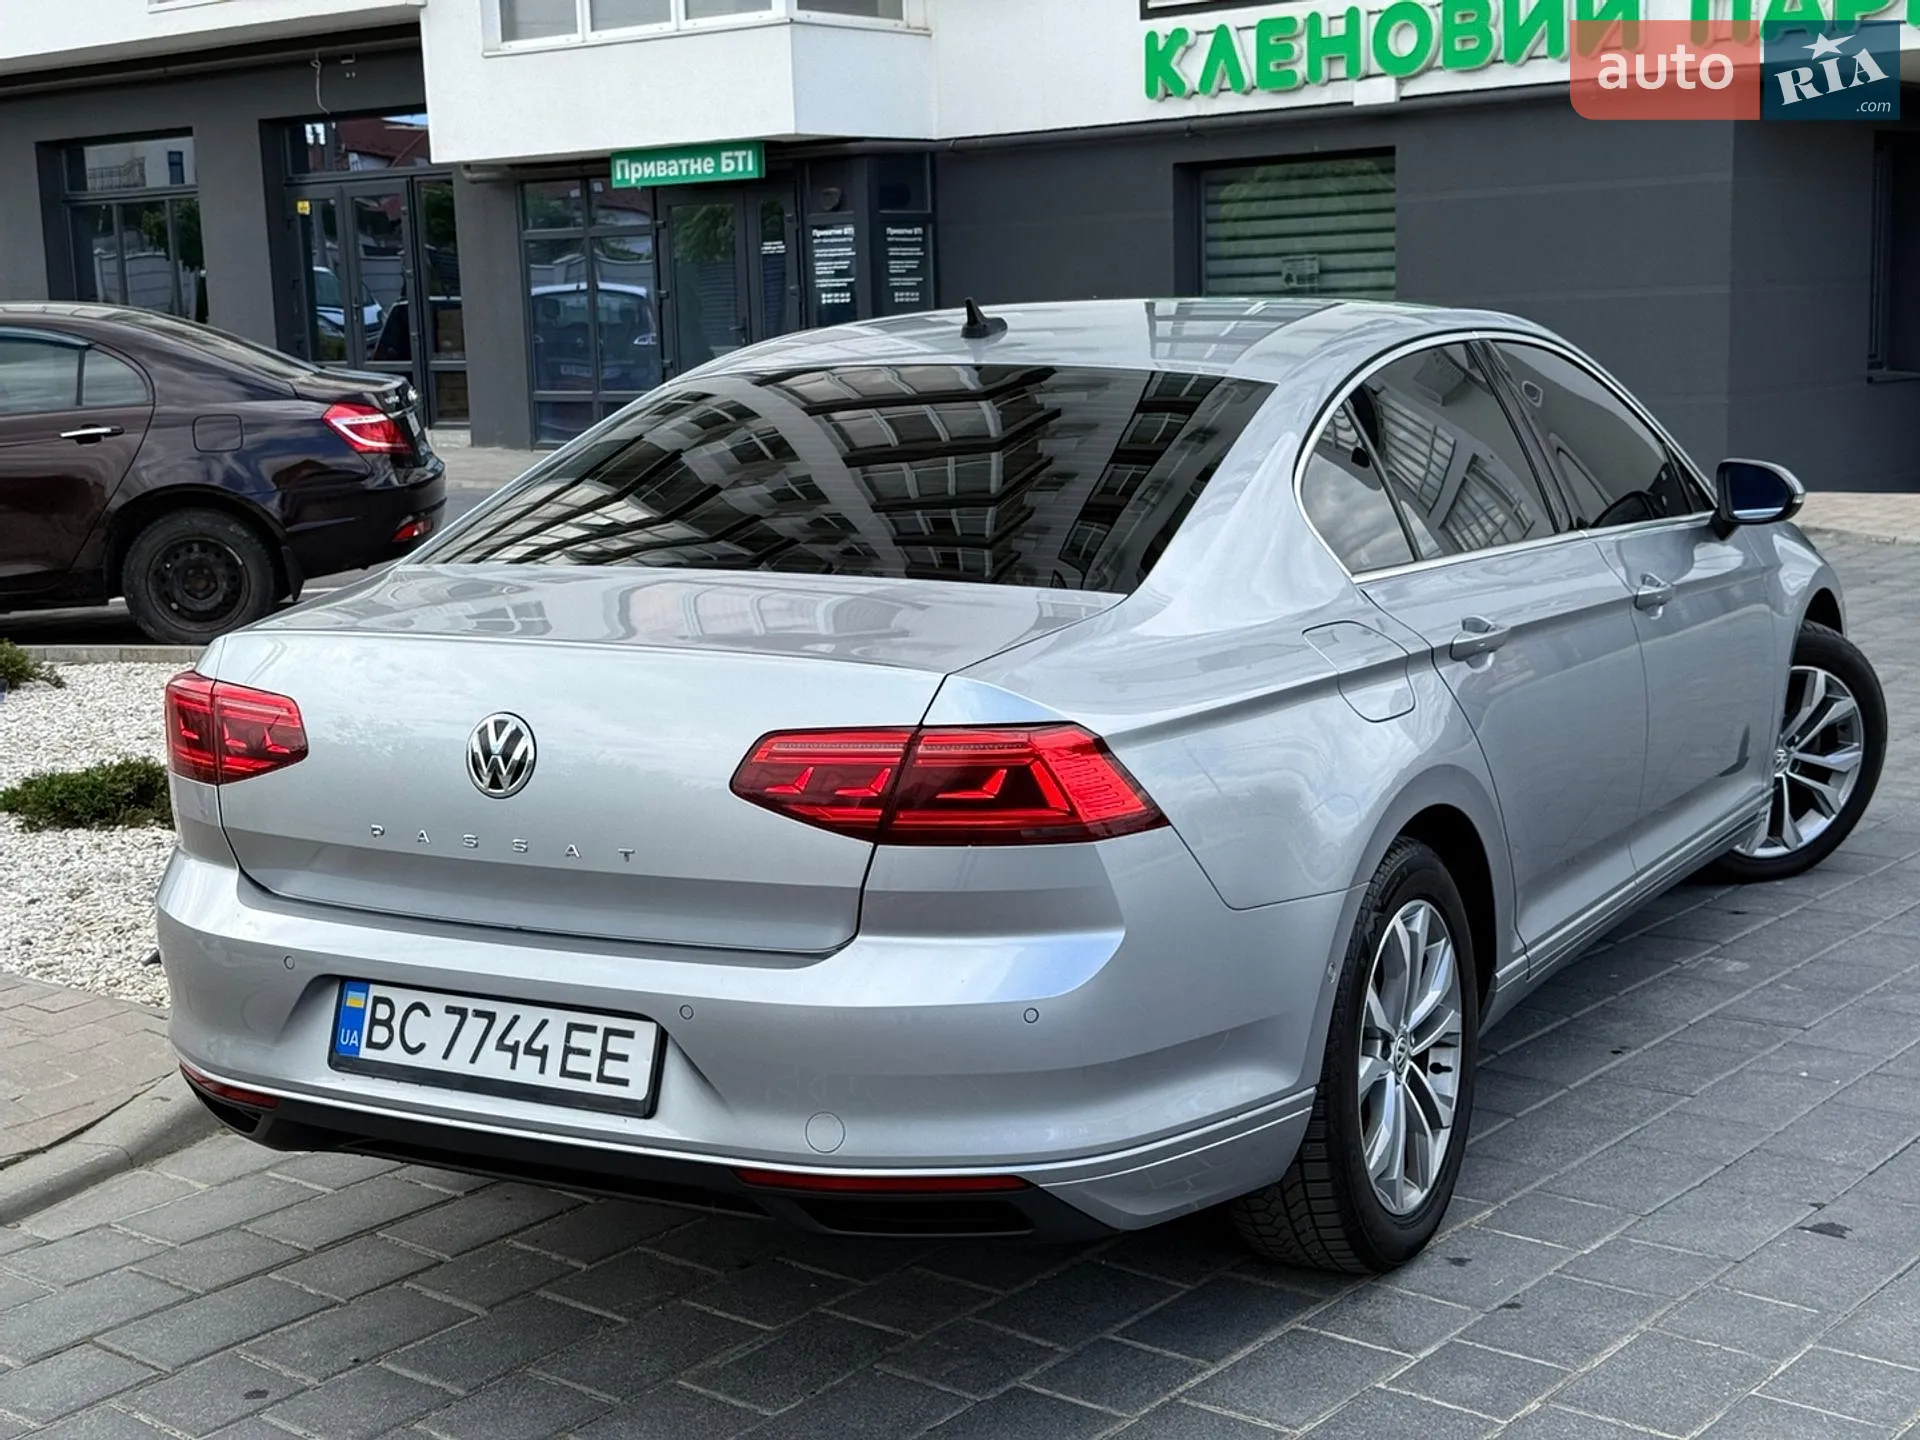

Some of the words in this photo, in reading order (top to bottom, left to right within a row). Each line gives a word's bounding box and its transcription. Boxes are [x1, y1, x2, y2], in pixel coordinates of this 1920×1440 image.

[615, 156, 716, 185] Приватне
[720, 150, 754, 174] БТІ
[469, 714, 535, 797] VW
[370, 823, 636, 862] PASSAT
[340, 1028, 359, 1048] UA
